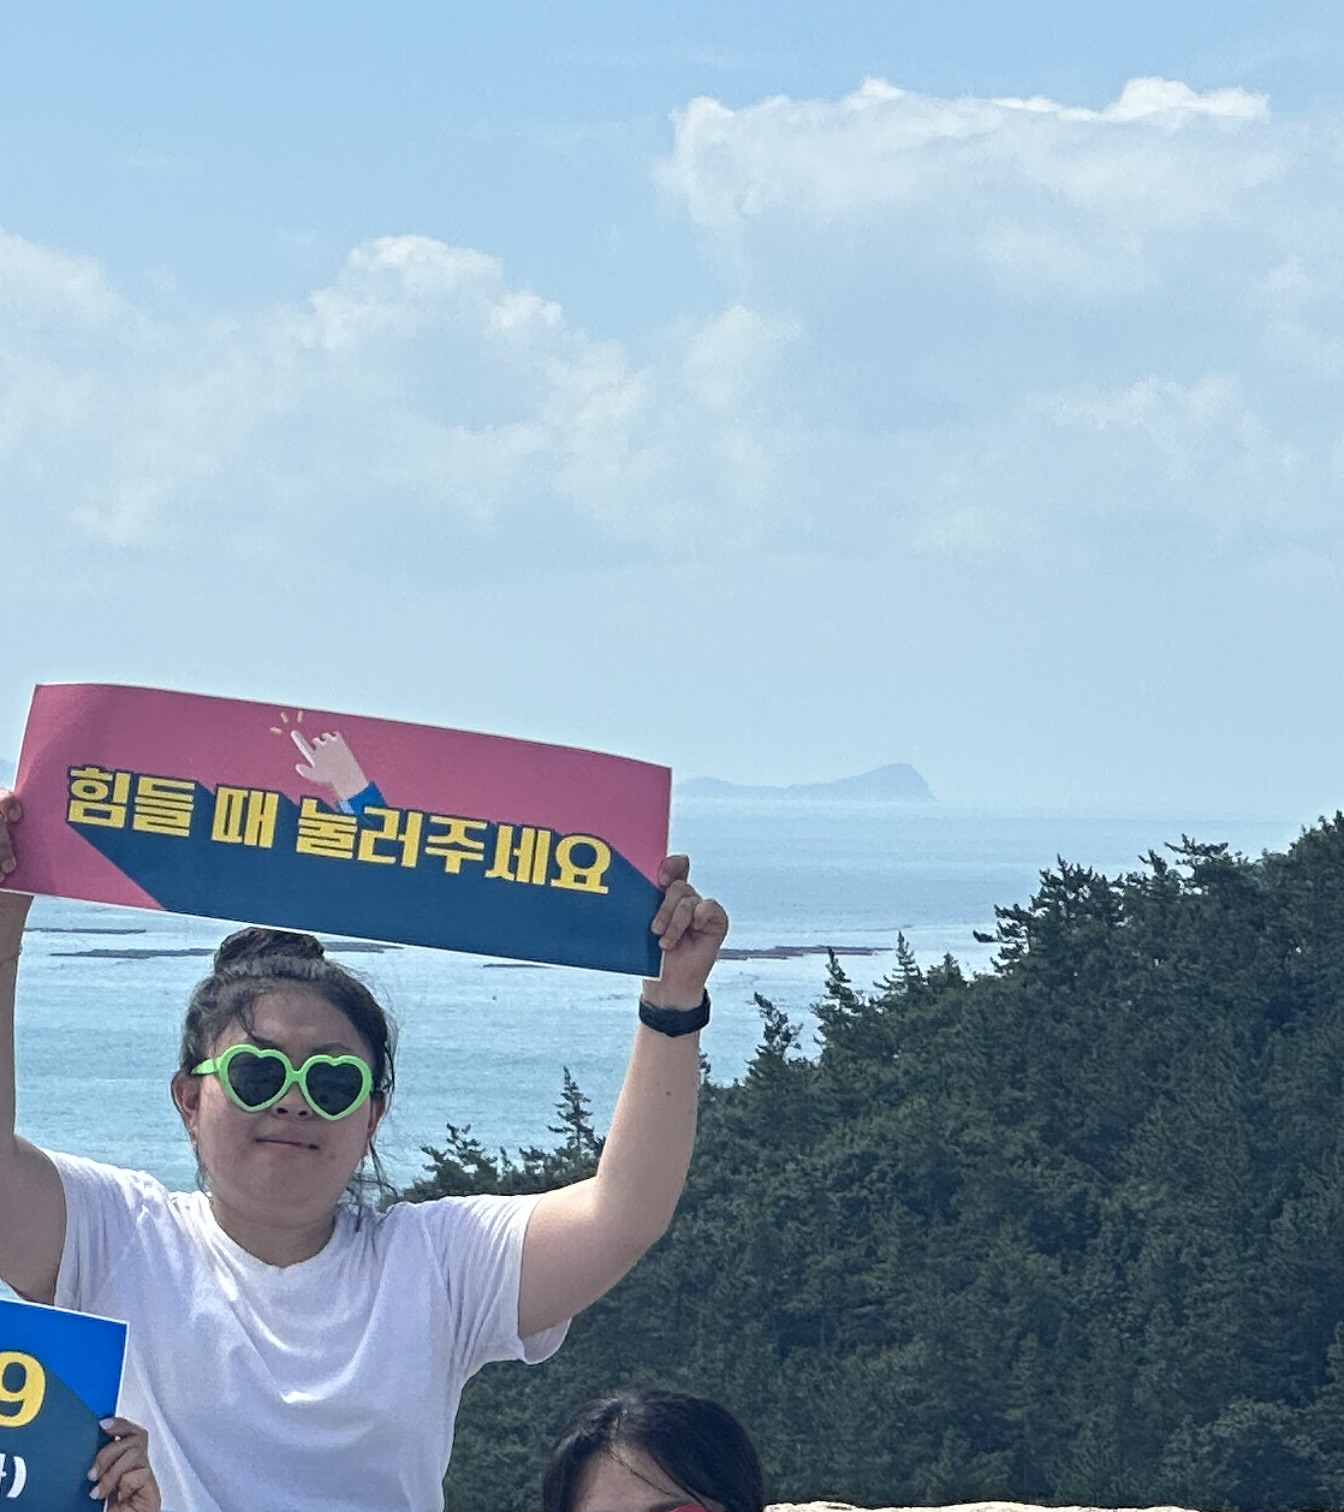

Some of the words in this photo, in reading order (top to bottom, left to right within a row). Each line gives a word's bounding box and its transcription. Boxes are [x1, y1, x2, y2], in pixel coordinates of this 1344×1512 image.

[67, 765, 196, 838] 힘들
[212, 786, 278, 848] 때
[296, 799, 612, 895] 눌러주세요
